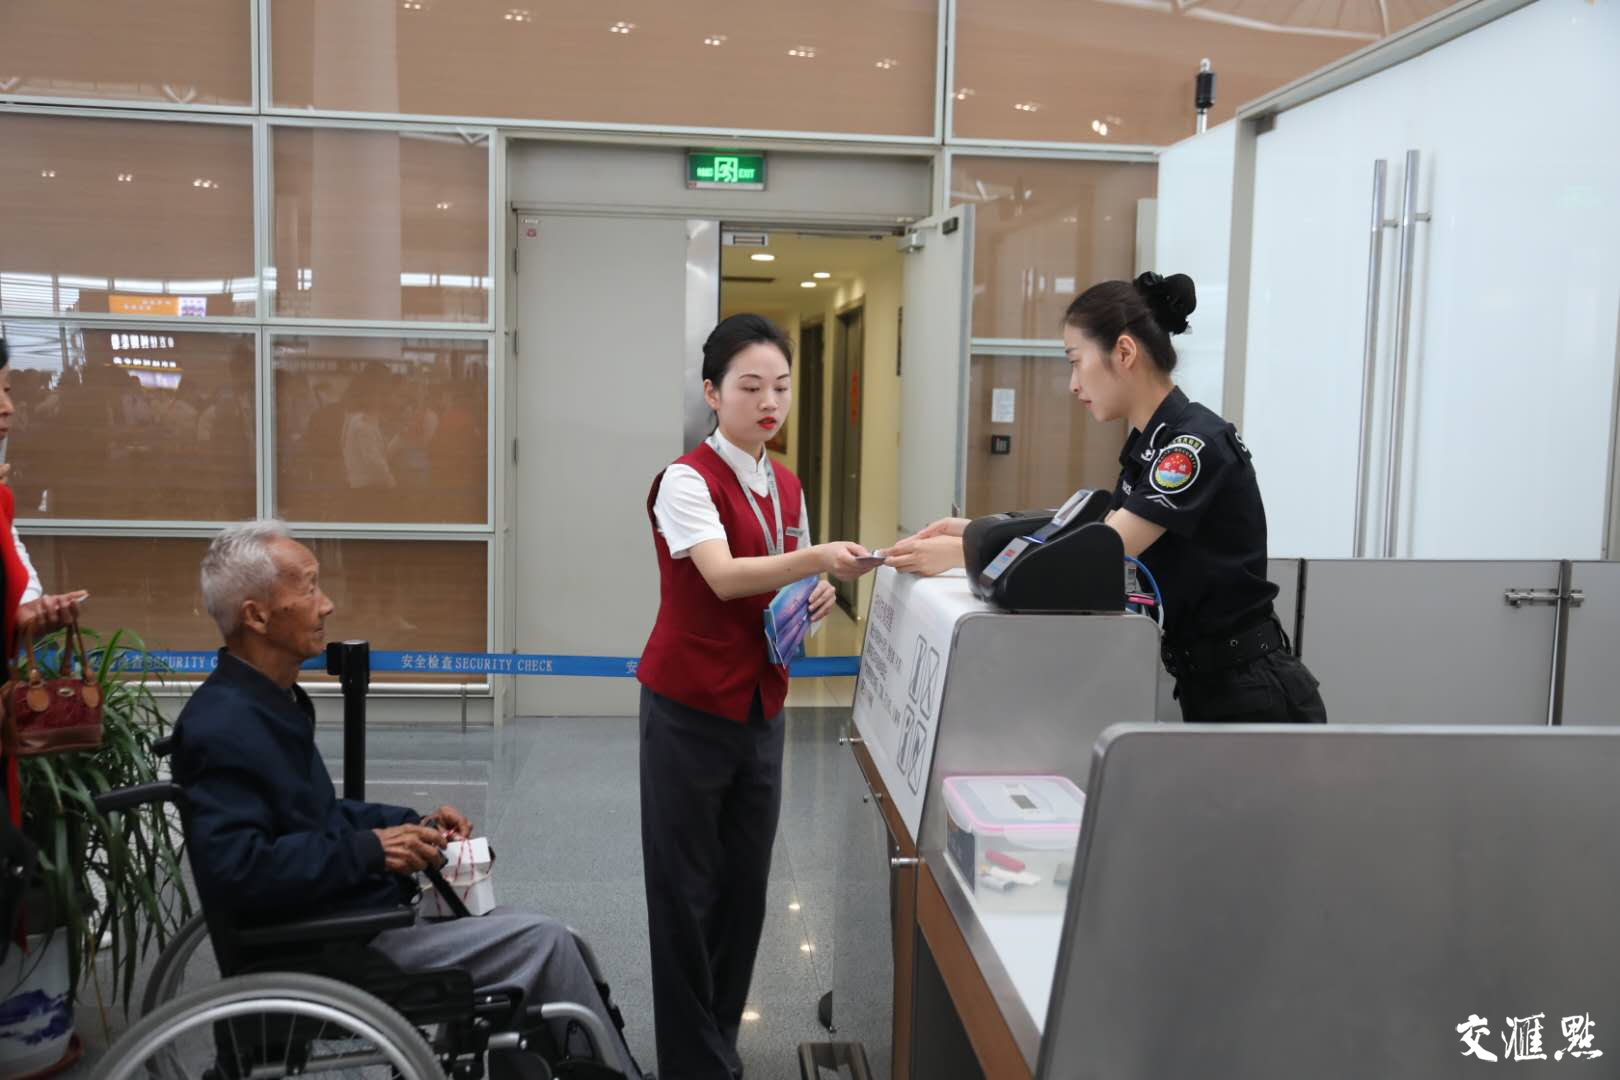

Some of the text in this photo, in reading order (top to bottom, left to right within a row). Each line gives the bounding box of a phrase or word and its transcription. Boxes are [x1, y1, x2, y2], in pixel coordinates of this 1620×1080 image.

[401, 653, 553, 672] 安全检查 SECURITY CHECK
